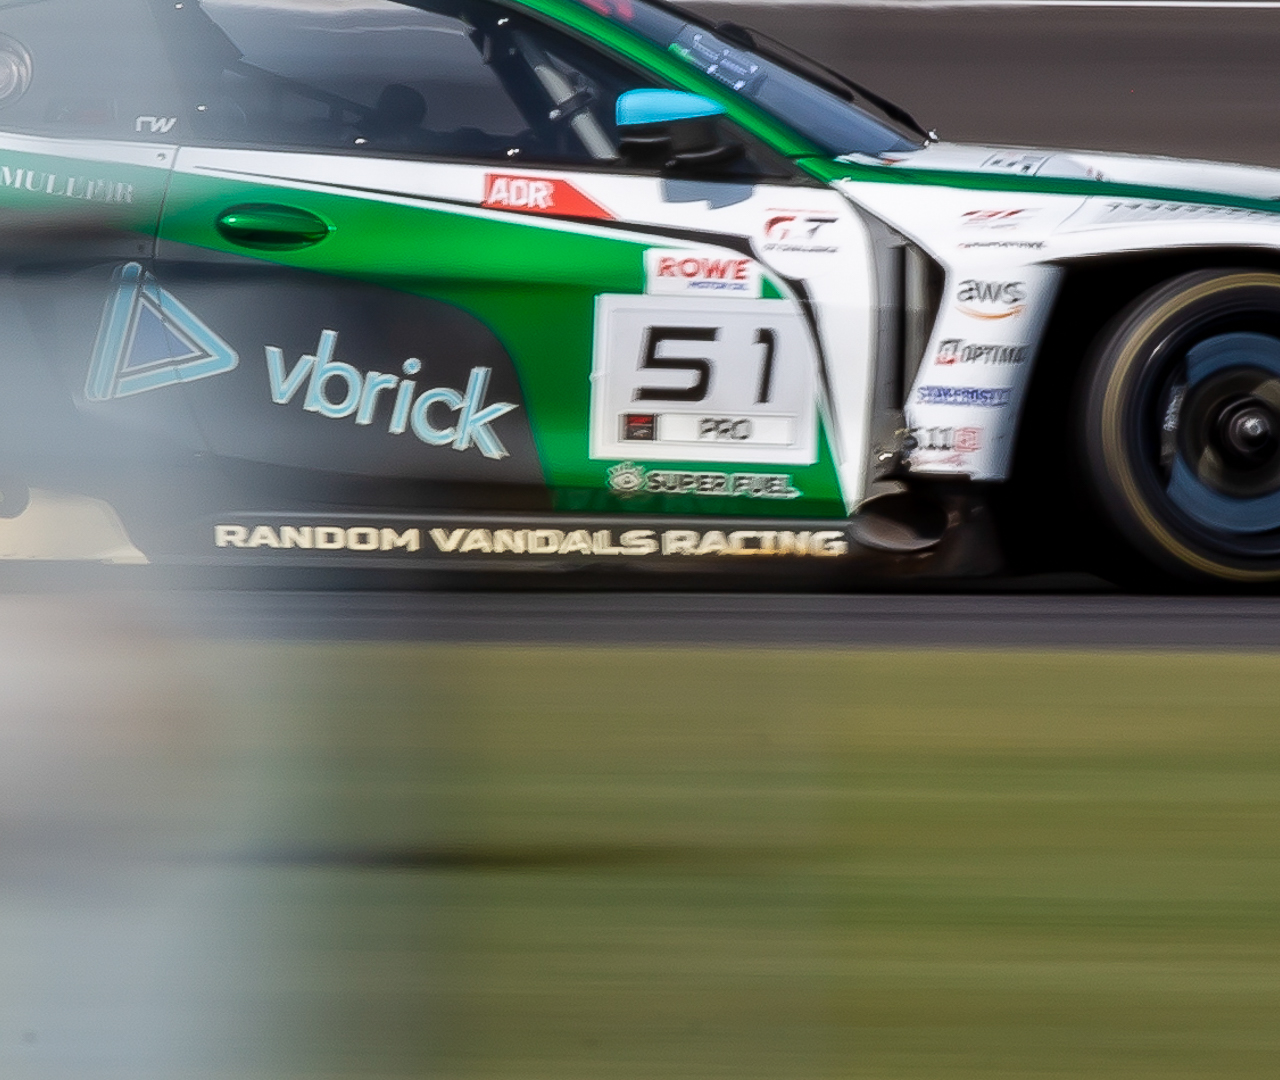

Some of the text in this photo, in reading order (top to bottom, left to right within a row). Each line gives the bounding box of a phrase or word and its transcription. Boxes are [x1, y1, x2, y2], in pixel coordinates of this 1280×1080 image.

[487, 177, 555, 209] ADR
[657, 256, 751, 281] ROWE
[956, 279, 1026, 304] aws
[630, 325, 780, 405] 51
[264, 329, 519, 460] vbrick
[646, 471, 727, 494] SUPER
[214, 525, 849, 558] RANDOM VANDALS RACING
